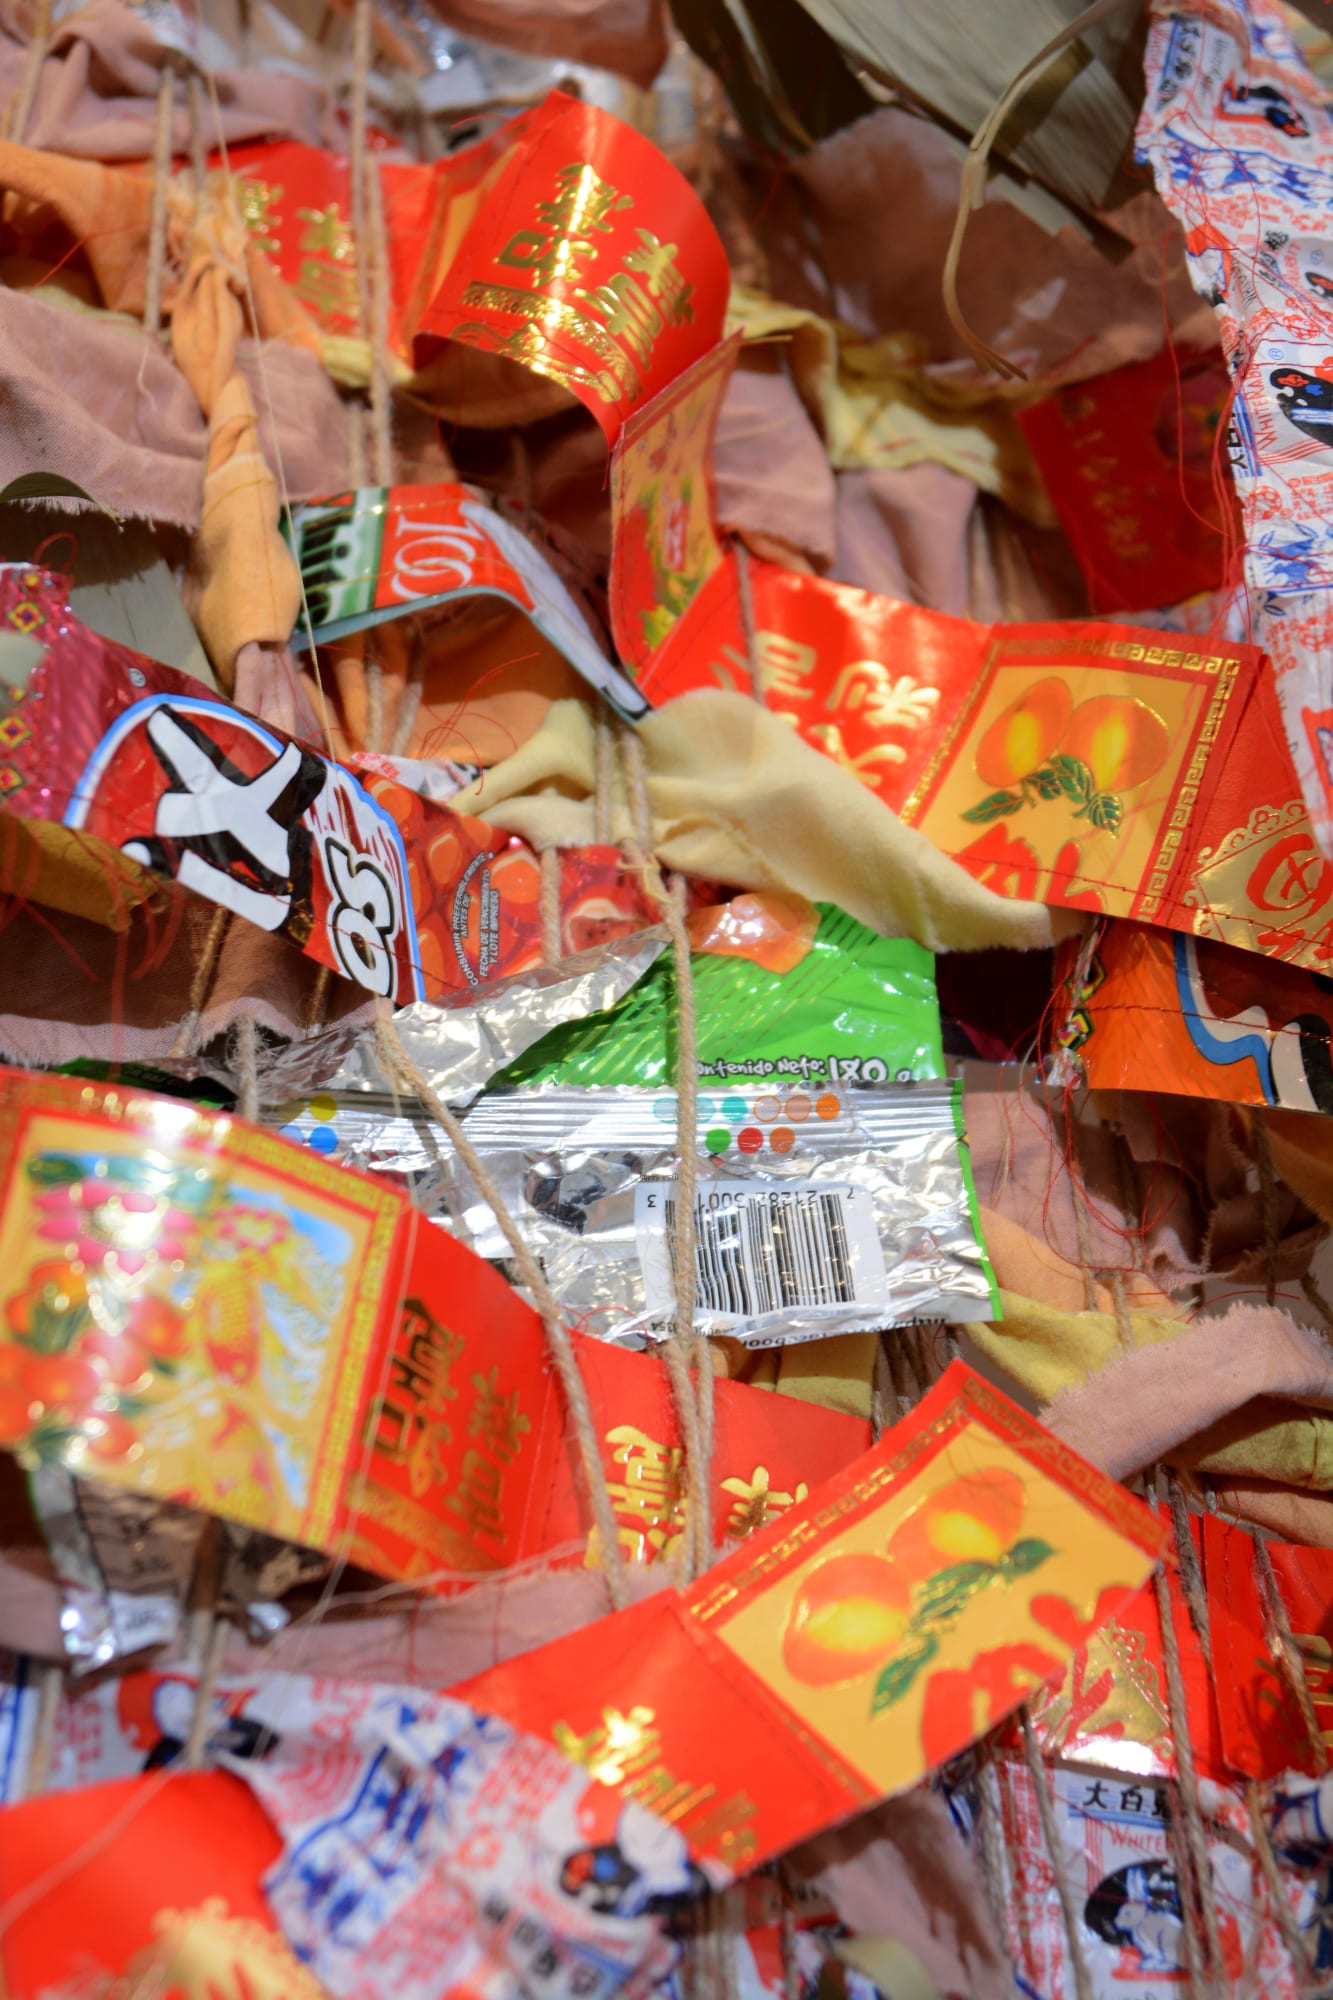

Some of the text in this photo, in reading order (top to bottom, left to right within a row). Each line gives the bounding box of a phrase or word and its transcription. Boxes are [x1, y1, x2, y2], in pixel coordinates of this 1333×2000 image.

[453, 851, 486, 986] CONSUMIR PREFERIBLEMENTE
[460, 892, 471, 938] ANTES DE
[479, 868, 490, 977] FECHA DE VENCIMIENTO
[489, 889, 499, 931] IMPRESO
[489, 931, 498, 956] LOTE
[697, 1057, 773, 1077] ontenido
[777, 1056, 826, 1078] Neto:
[829, 1055, 889, 1081] 180
[647, 1194, 657, 1208] 3
[846, 1187, 856, 1200] 7
